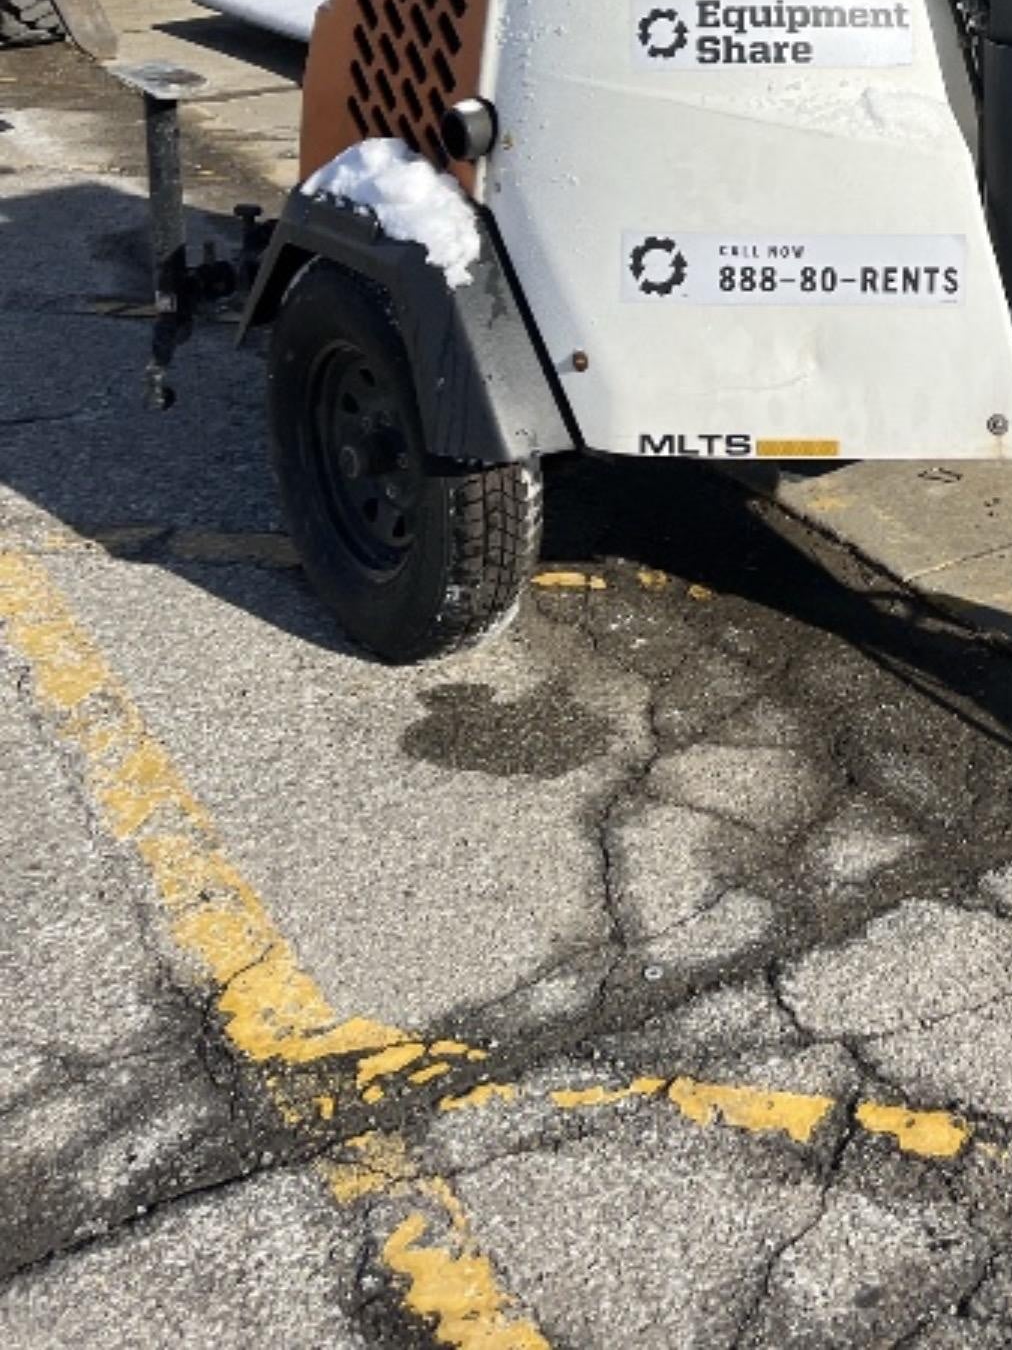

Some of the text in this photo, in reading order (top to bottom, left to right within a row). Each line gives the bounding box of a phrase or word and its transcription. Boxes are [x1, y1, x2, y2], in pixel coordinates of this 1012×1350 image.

[696, 0, 910, 33] Equipment
[696, 35, 814, 64] Share
[719, 245, 805, 259] CALL NOW
[719, 266, 958, 294] 888-80-RENTS
[639, 434, 752, 456] MLTS
